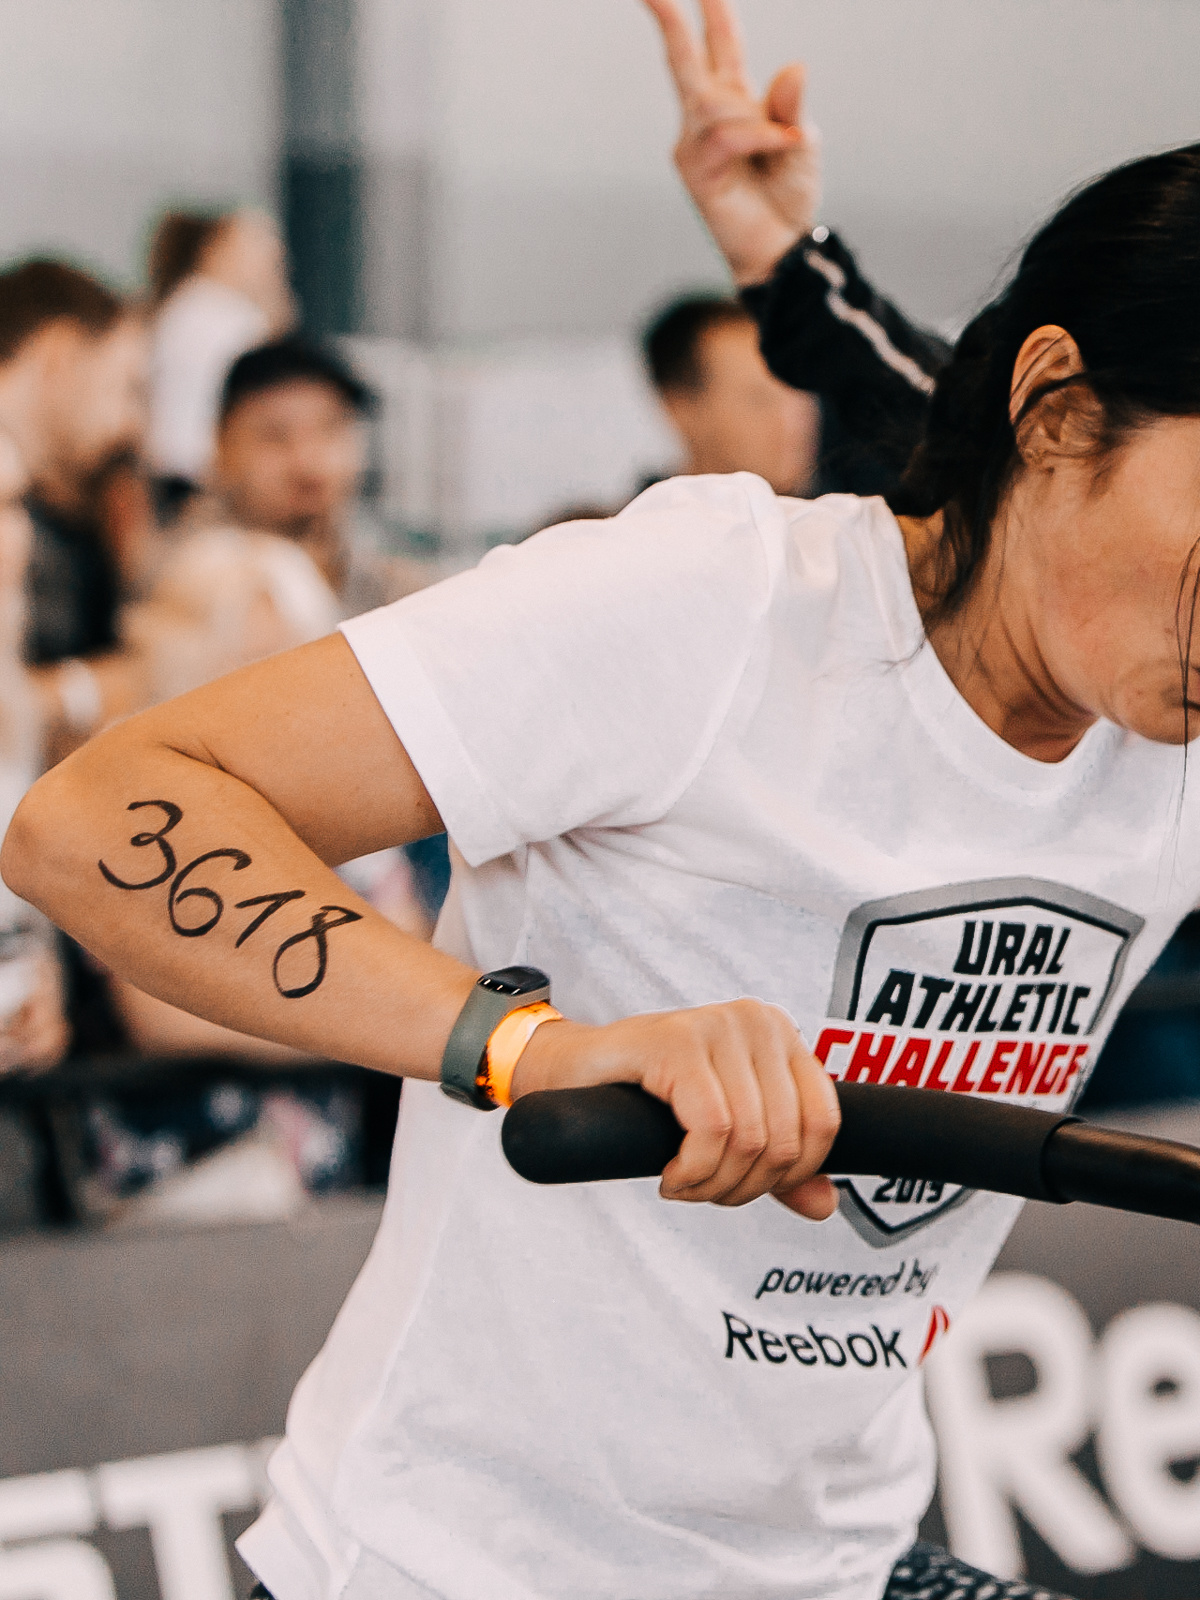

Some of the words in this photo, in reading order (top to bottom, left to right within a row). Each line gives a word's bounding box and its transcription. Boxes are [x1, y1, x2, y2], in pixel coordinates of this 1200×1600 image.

[98, 799, 364, 999] 3618
[953, 920, 1071, 976] URAL
[865, 968, 1091, 1035] ATHLETIC
[814, 1028, 1089, 1094] CHALLENGE
[872, 1177, 945, 1204] 2019
[755, 1261, 906, 1299] powered
[904, 1257, 938, 1298] by
[721, 1310, 907, 1368] Reebok
